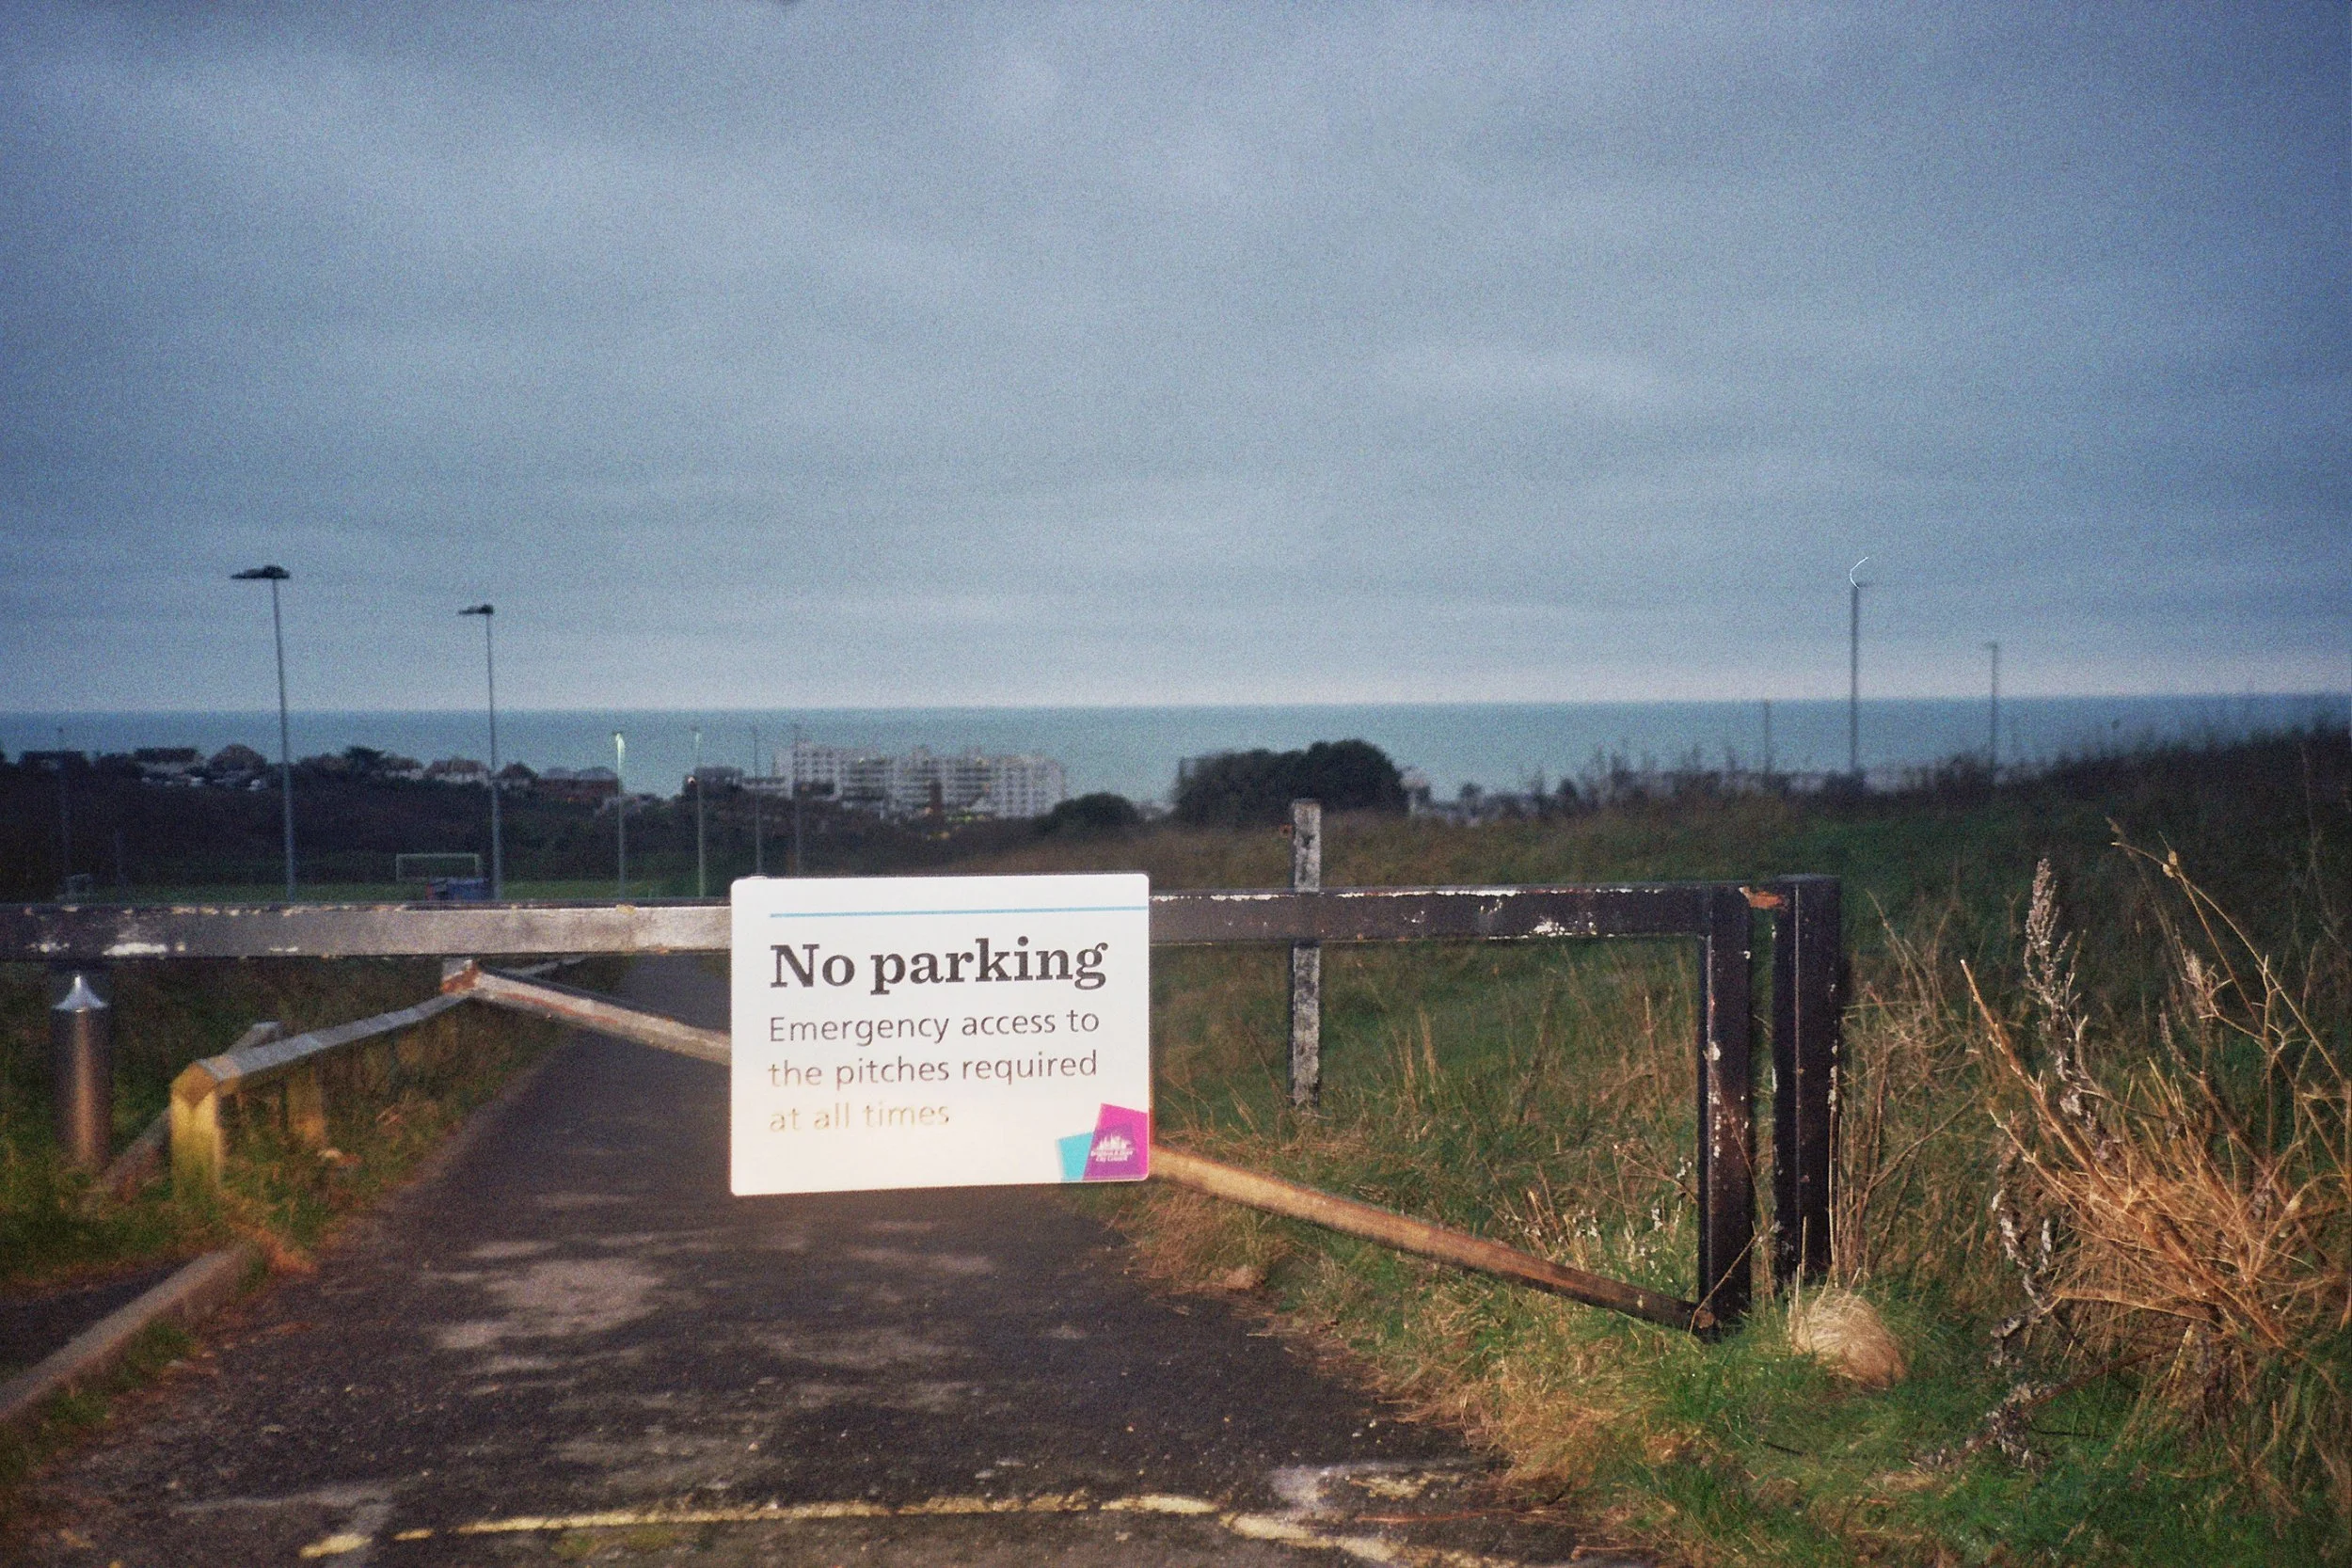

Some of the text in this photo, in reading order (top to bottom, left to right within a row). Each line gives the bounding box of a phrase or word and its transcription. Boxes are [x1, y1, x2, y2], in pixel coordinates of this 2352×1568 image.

[770, 936, 1109, 995] No parking
[770, 1009, 1100, 1047] Emergency access to
[769, 1049, 1097, 1090] the pitches required
[770, 1101, 950, 1132] at all times
